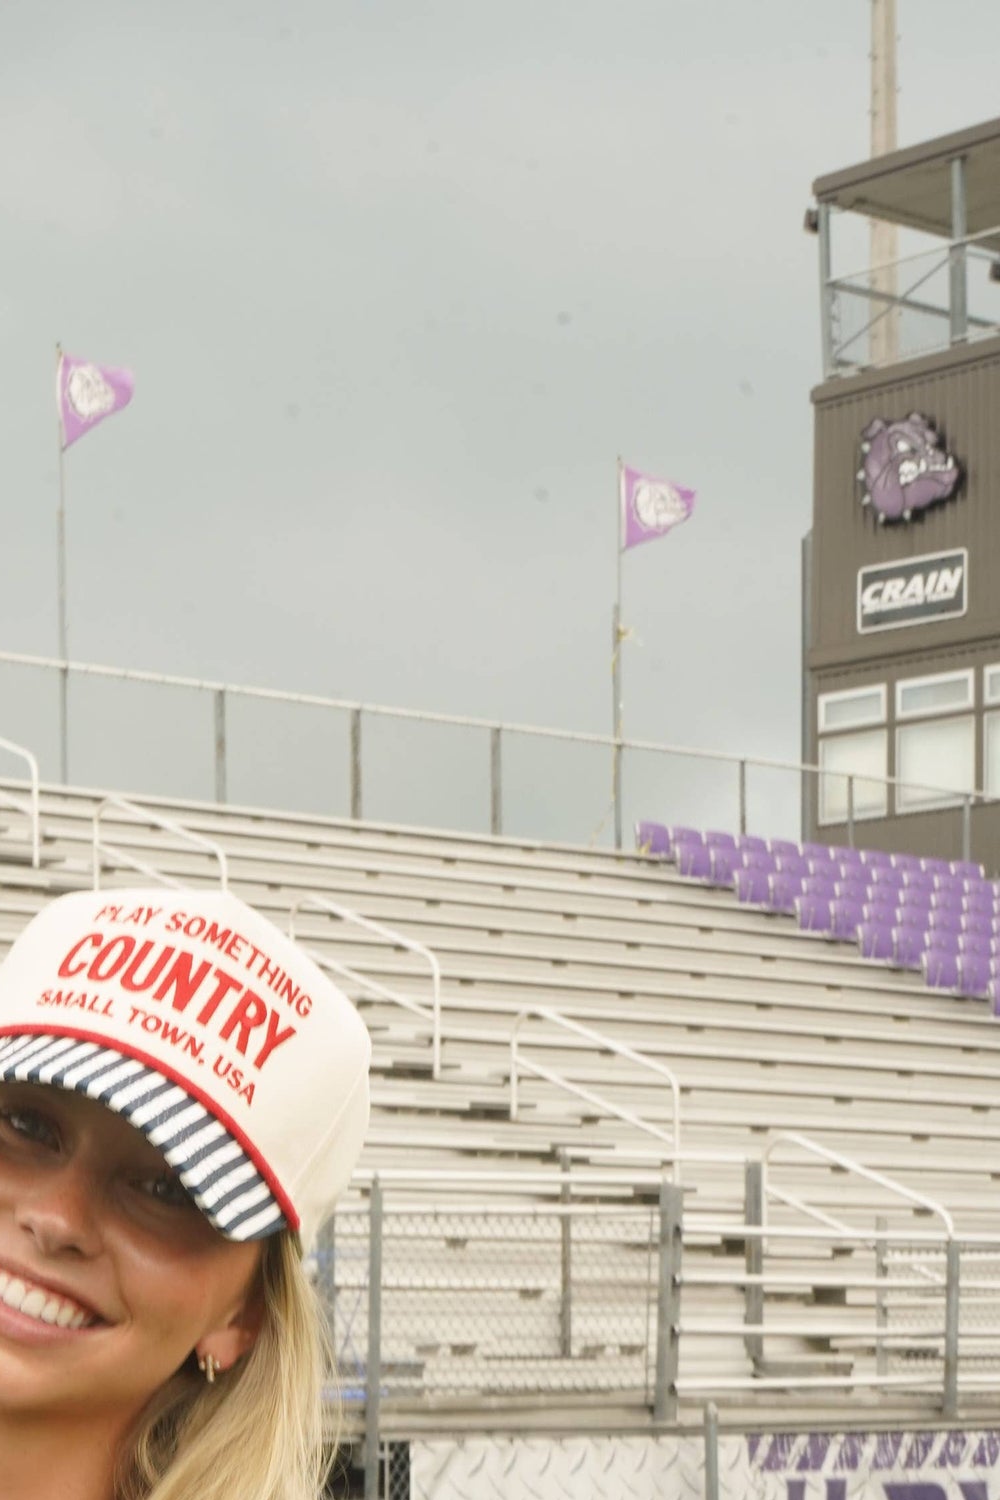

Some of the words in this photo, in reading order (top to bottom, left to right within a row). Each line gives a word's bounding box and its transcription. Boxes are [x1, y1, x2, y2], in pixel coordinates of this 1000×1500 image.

[861, 566, 963, 608] CRAIN
[57, 932, 297, 1071] COUNTRY
[95, 904, 163, 927] PLAY
[164, 911, 313, 1018] SOMETHING
[37, 989, 114, 1017] SMALL
[212, 1054, 256, 1106] USA
